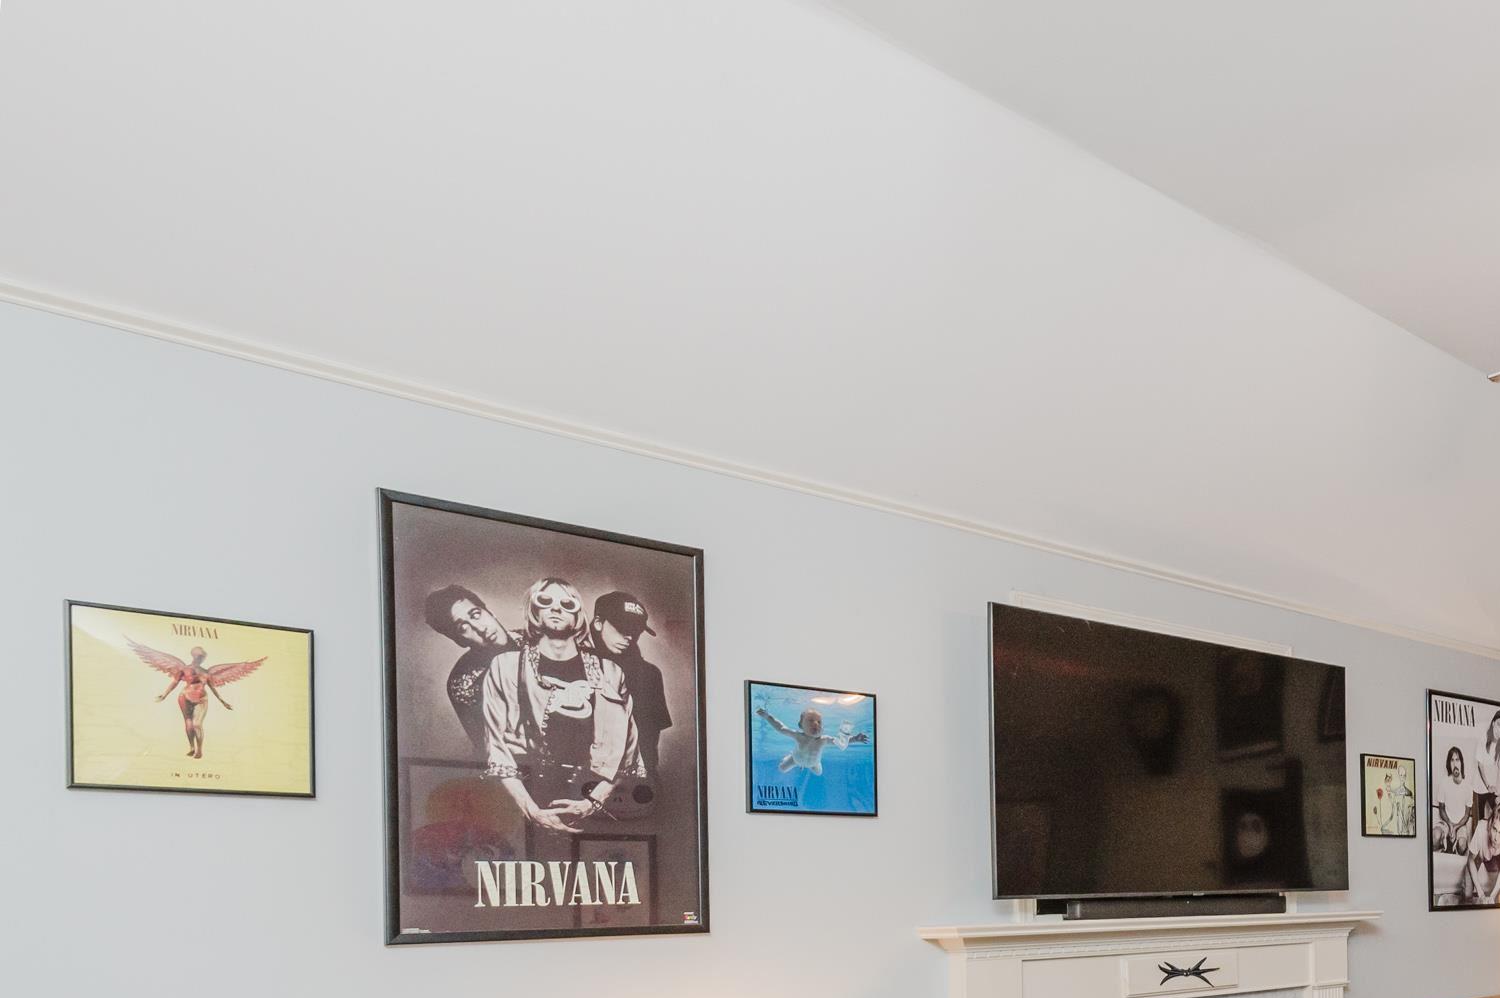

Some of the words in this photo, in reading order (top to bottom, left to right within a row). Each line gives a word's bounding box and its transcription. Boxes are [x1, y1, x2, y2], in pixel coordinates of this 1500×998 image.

[171, 623, 219, 640] NIRVANA
[1433, 699, 1475, 728] NIRVANA
[1366, 757, 1399, 770] NIRVANA
[757, 785, 799, 800] NIRVANA
[474, 860, 642, 908] NIRVANA
